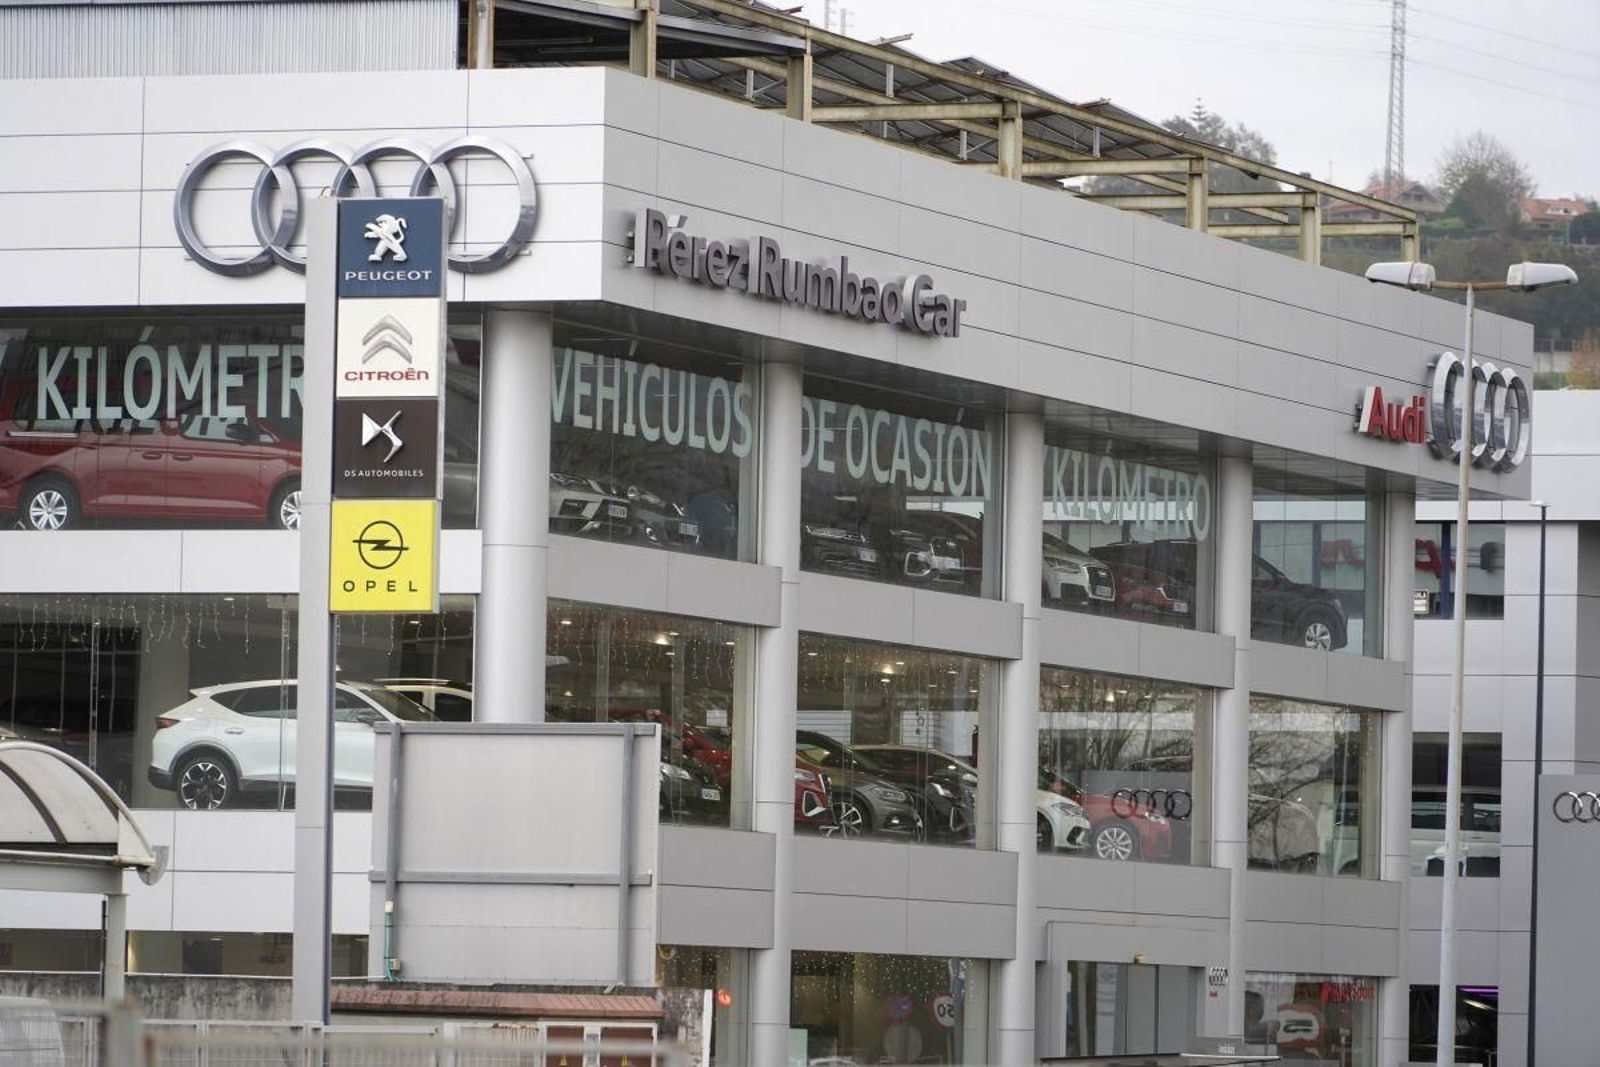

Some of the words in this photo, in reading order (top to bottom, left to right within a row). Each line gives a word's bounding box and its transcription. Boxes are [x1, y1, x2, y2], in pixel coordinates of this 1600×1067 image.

[345, 270, 432, 281] PEUGEOT
[635, 208, 749, 290] Pérez
[750, 235, 904, 325] Rumbao
[904, 274, 967, 338] Car
[551, 340, 752, 458] VEHÍCULOS
[801, 395, 837, 474] DE
[845, 406, 991, 500] OCASIÓN
[1052, 439, 1210, 542] KILÓMETRO
[1359, 386, 1426, 445] Audi
[343, 580, 418, 593] OPEL
